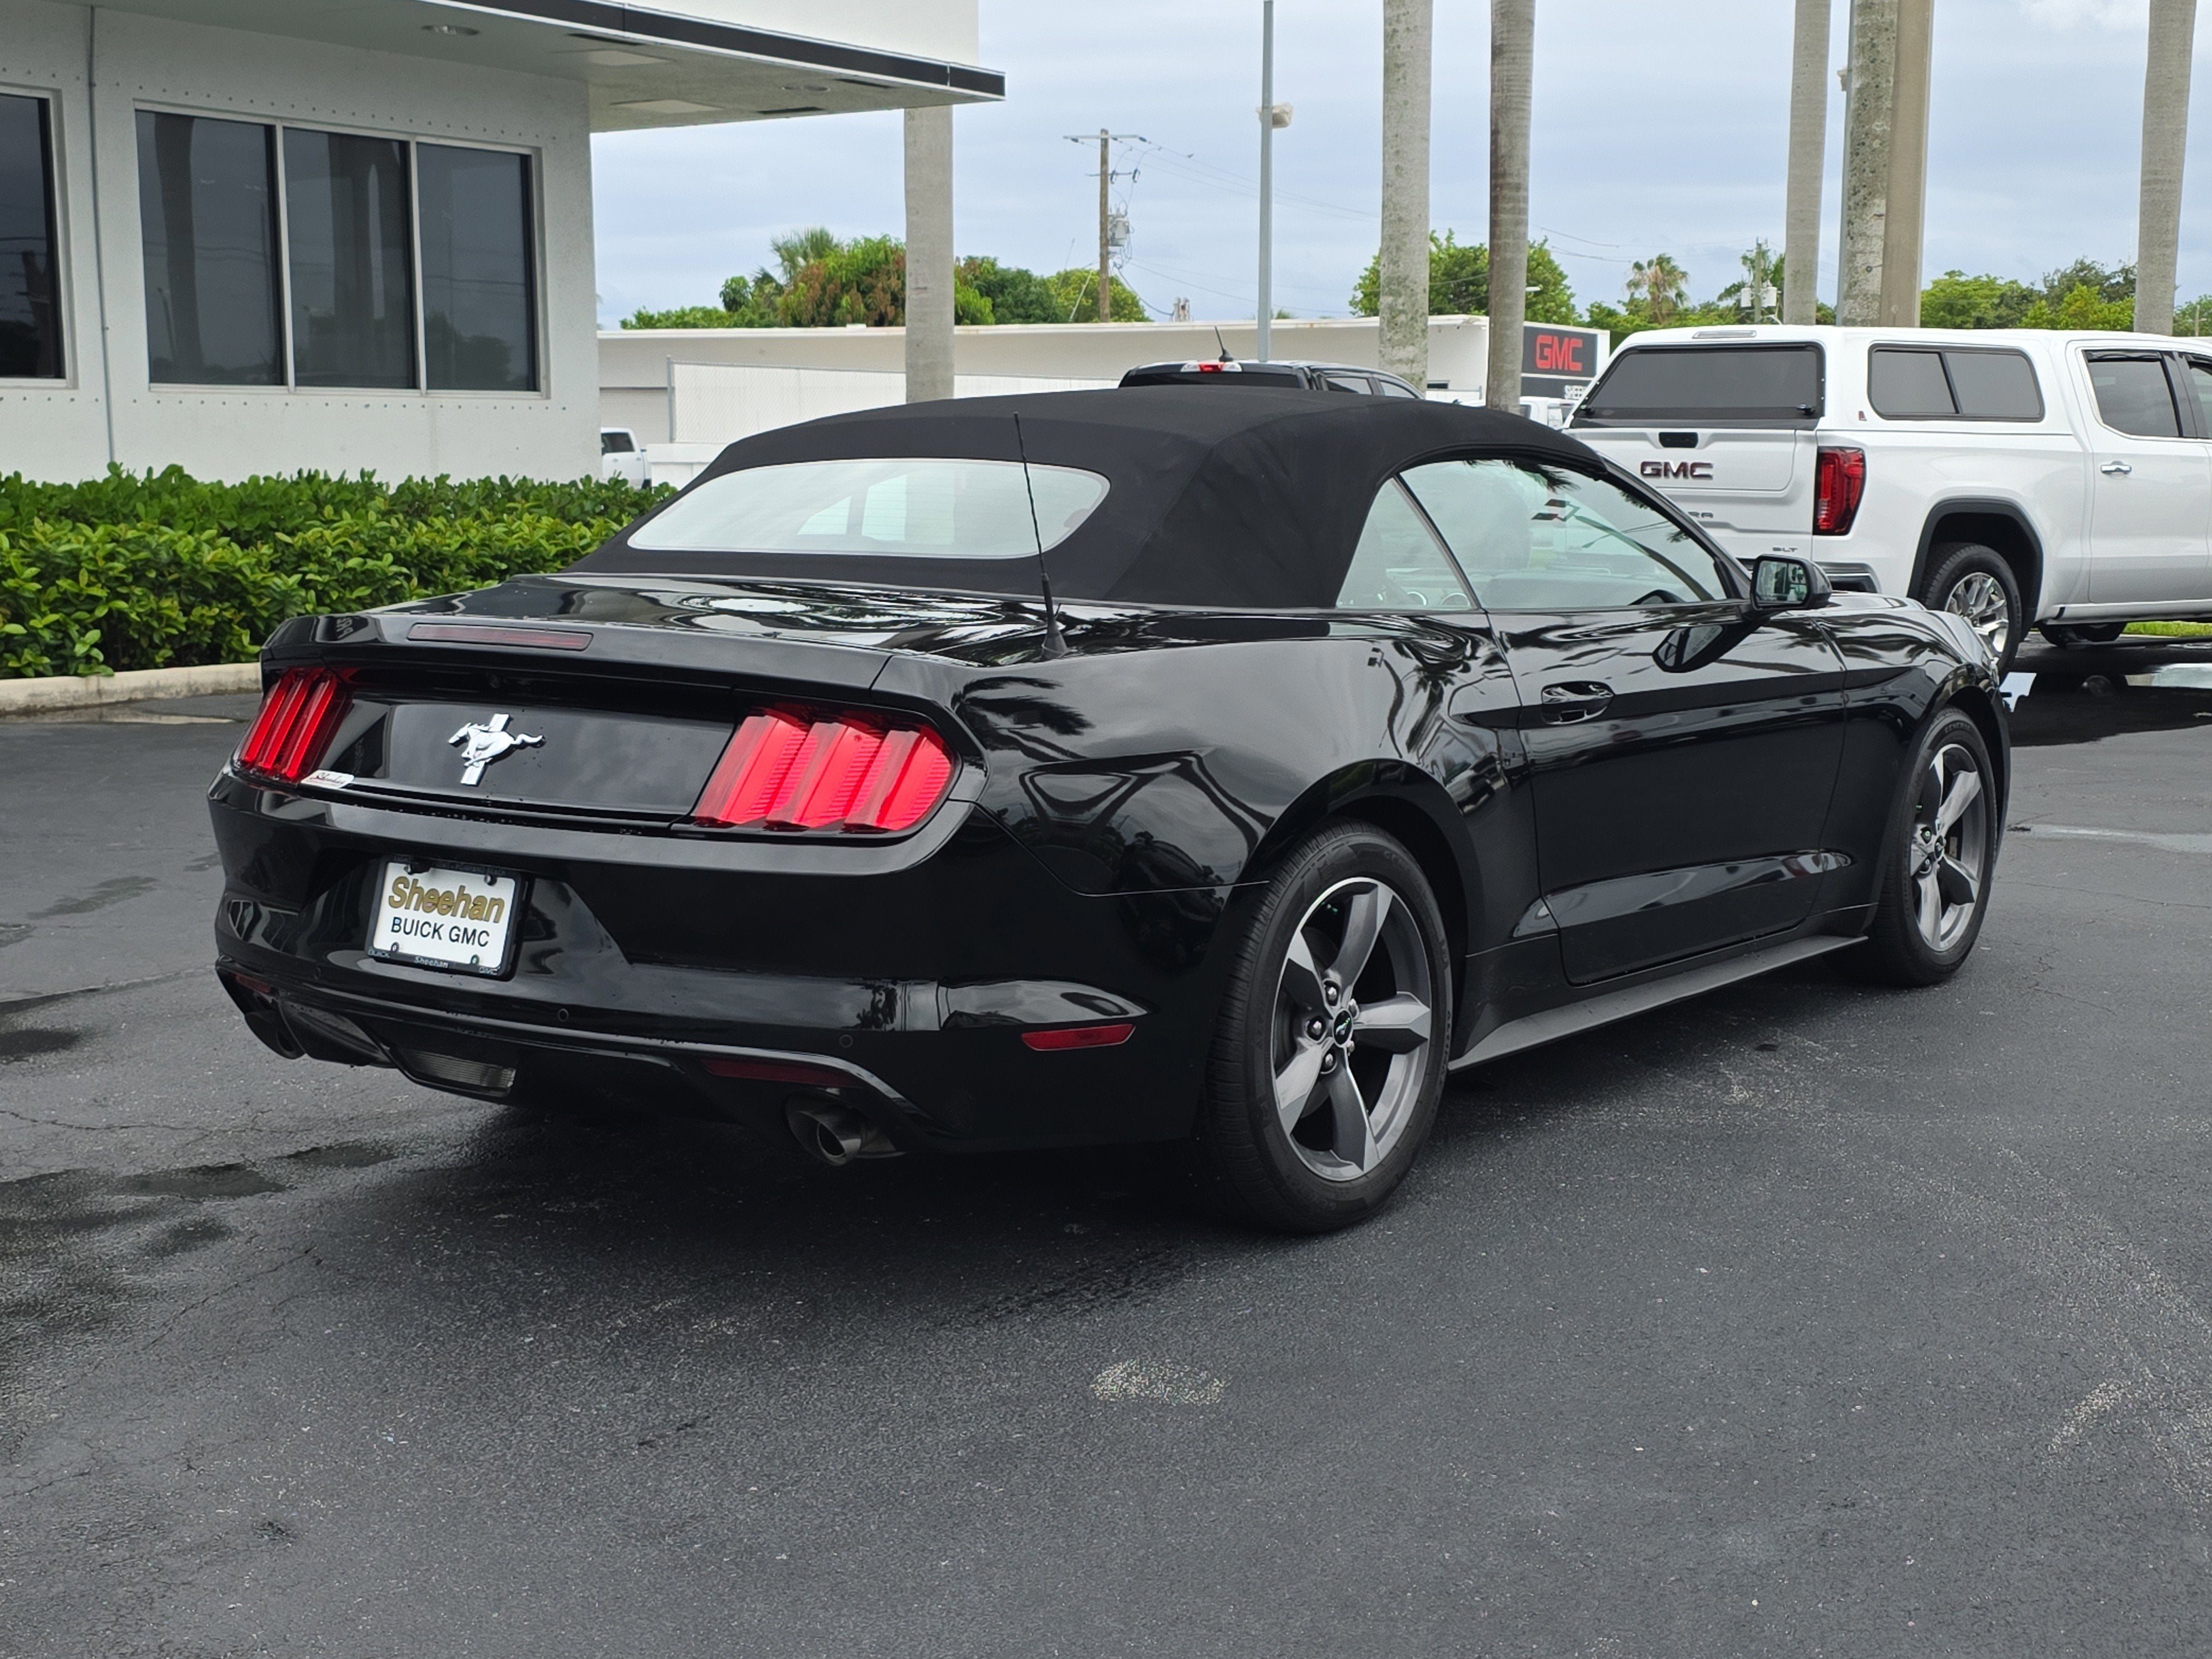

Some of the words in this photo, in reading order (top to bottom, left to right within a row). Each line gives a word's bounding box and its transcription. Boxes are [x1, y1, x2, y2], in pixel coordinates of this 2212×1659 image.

[1535, 334, 1583, 371] GMC
[1641, 461, 1713, 480] GMC
[388, 876, 505, 924] Sheehan
[391, 916, 445, 941] BUICK
[448, 926, 490, 947] GMC
[414, 956, 449, 968] Sheehan
